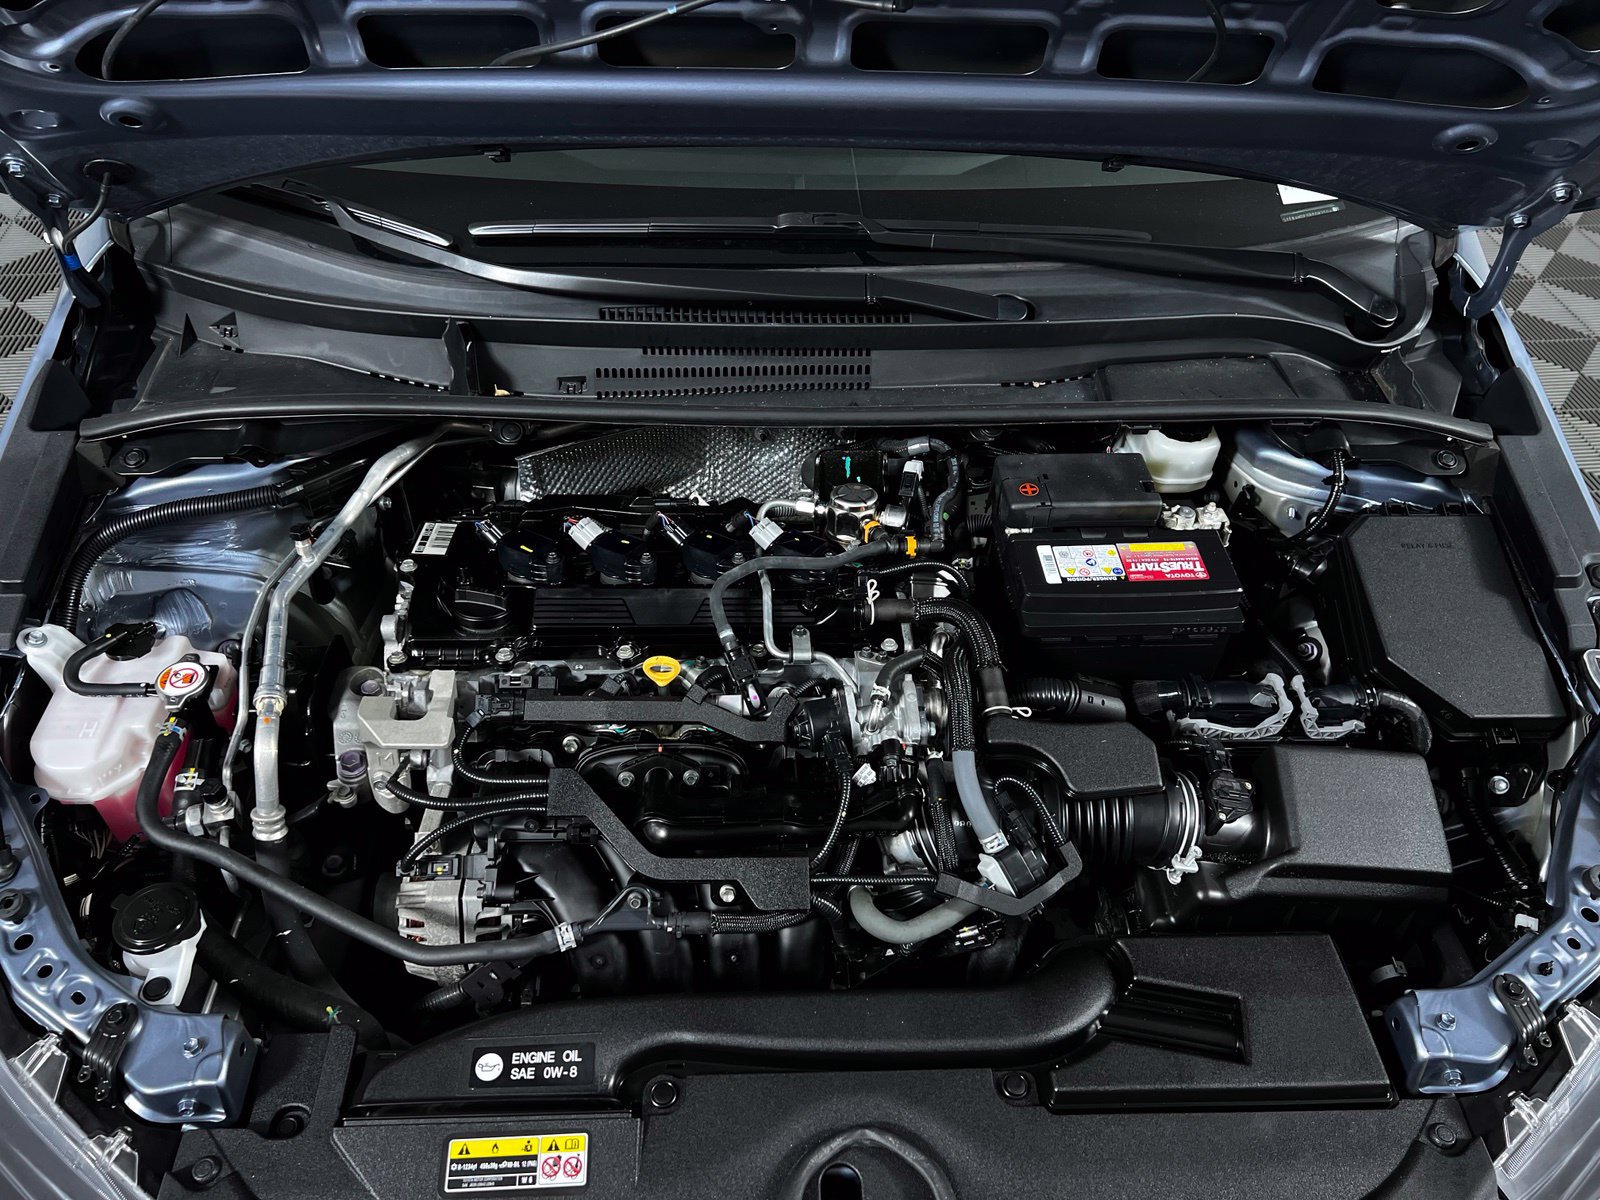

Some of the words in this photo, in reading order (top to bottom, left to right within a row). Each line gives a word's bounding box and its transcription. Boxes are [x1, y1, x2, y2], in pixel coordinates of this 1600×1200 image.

[511, 1051, 556, 1064] ENGINE
[562, 1050, 582, 1062] OIL
[510, 1067, 535, 1080] SAE
[543, 1065, 578, 1079] 0W-8
